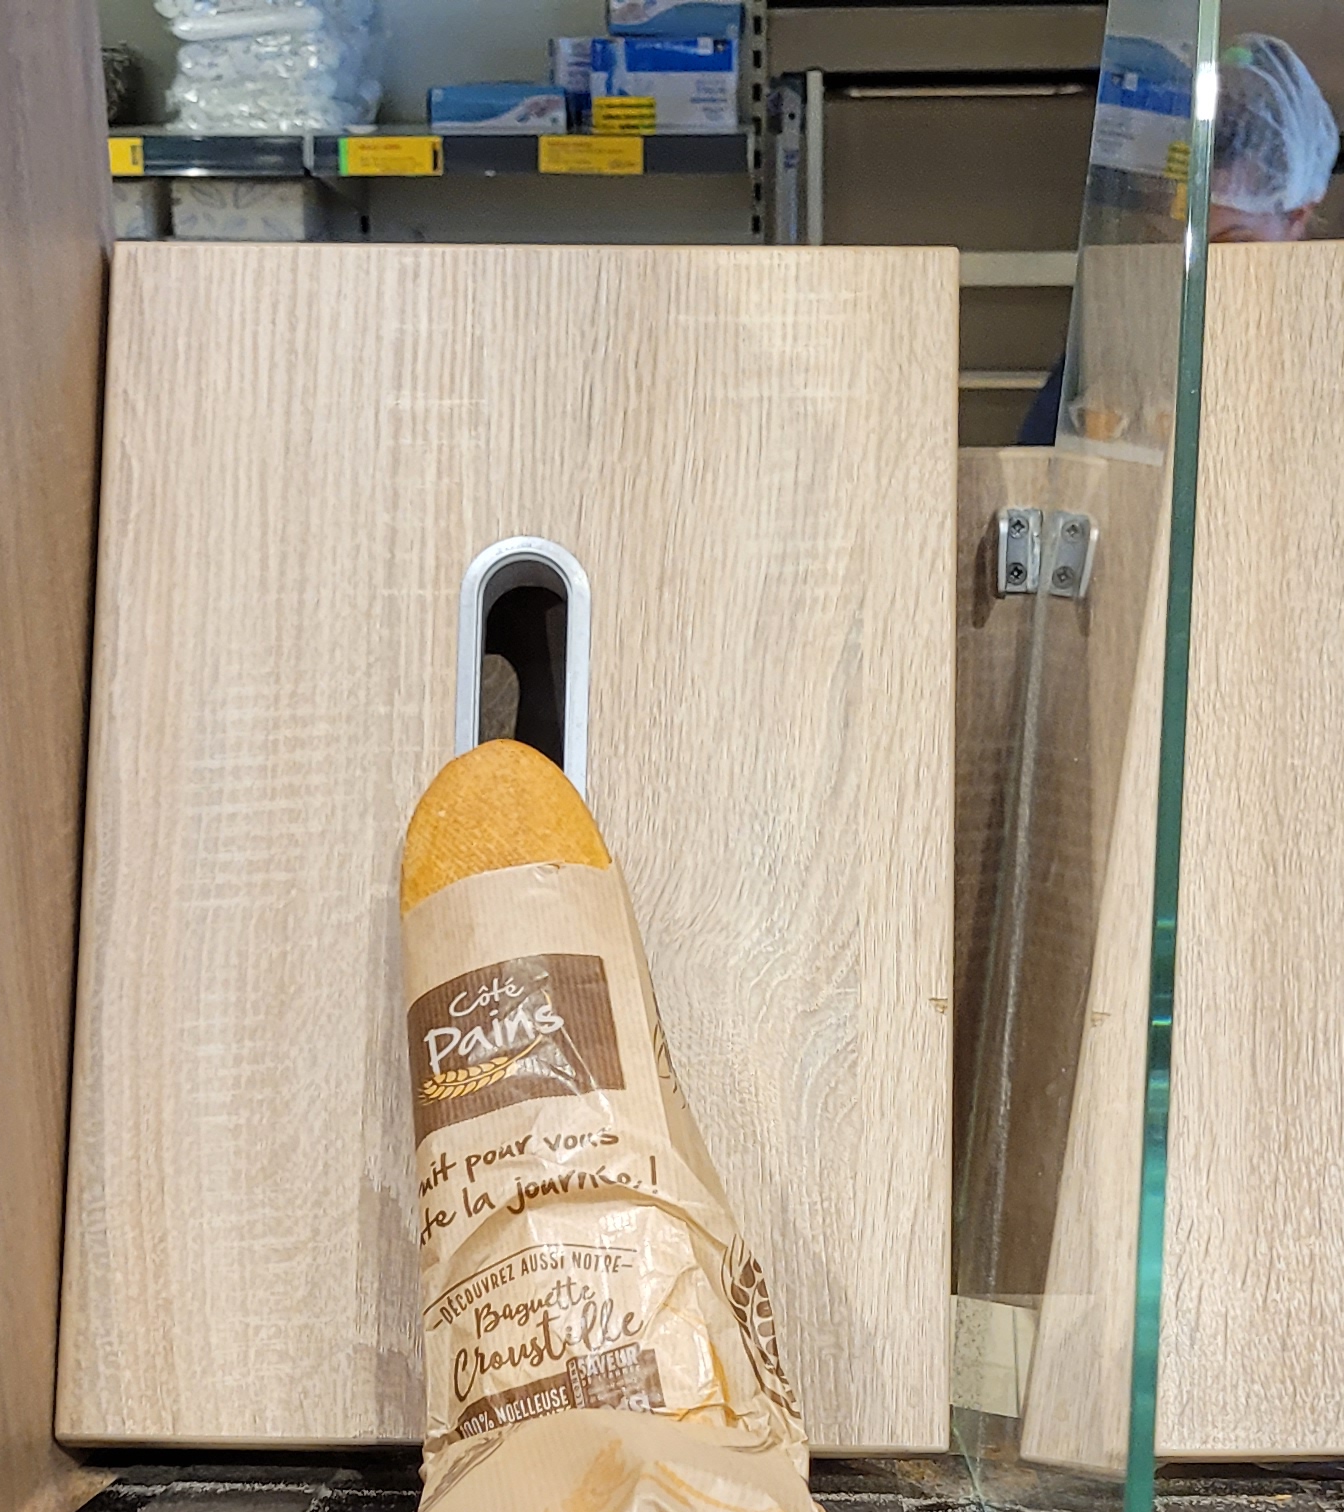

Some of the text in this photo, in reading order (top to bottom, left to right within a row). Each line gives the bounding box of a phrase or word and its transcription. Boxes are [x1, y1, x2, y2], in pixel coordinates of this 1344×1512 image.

[448, 976, 525, 1018] Côté
[423, 996, 564, 1075] Pains
[465, 1134, 533, 1183] pour
[543, 1127, 619, 1151] vous
[462, 1187, 496, 1218] la
[439, 1251, 623, 1325] DÉCOUVREZ AUSSI NOTRE
[474, 1275, 596, 1340] Baguette
[453, 1298, 644, 1402] Croustille
[577, 1347, 639, 1380] SAVEUR
[459, 1411, 495, 1439] 100%
